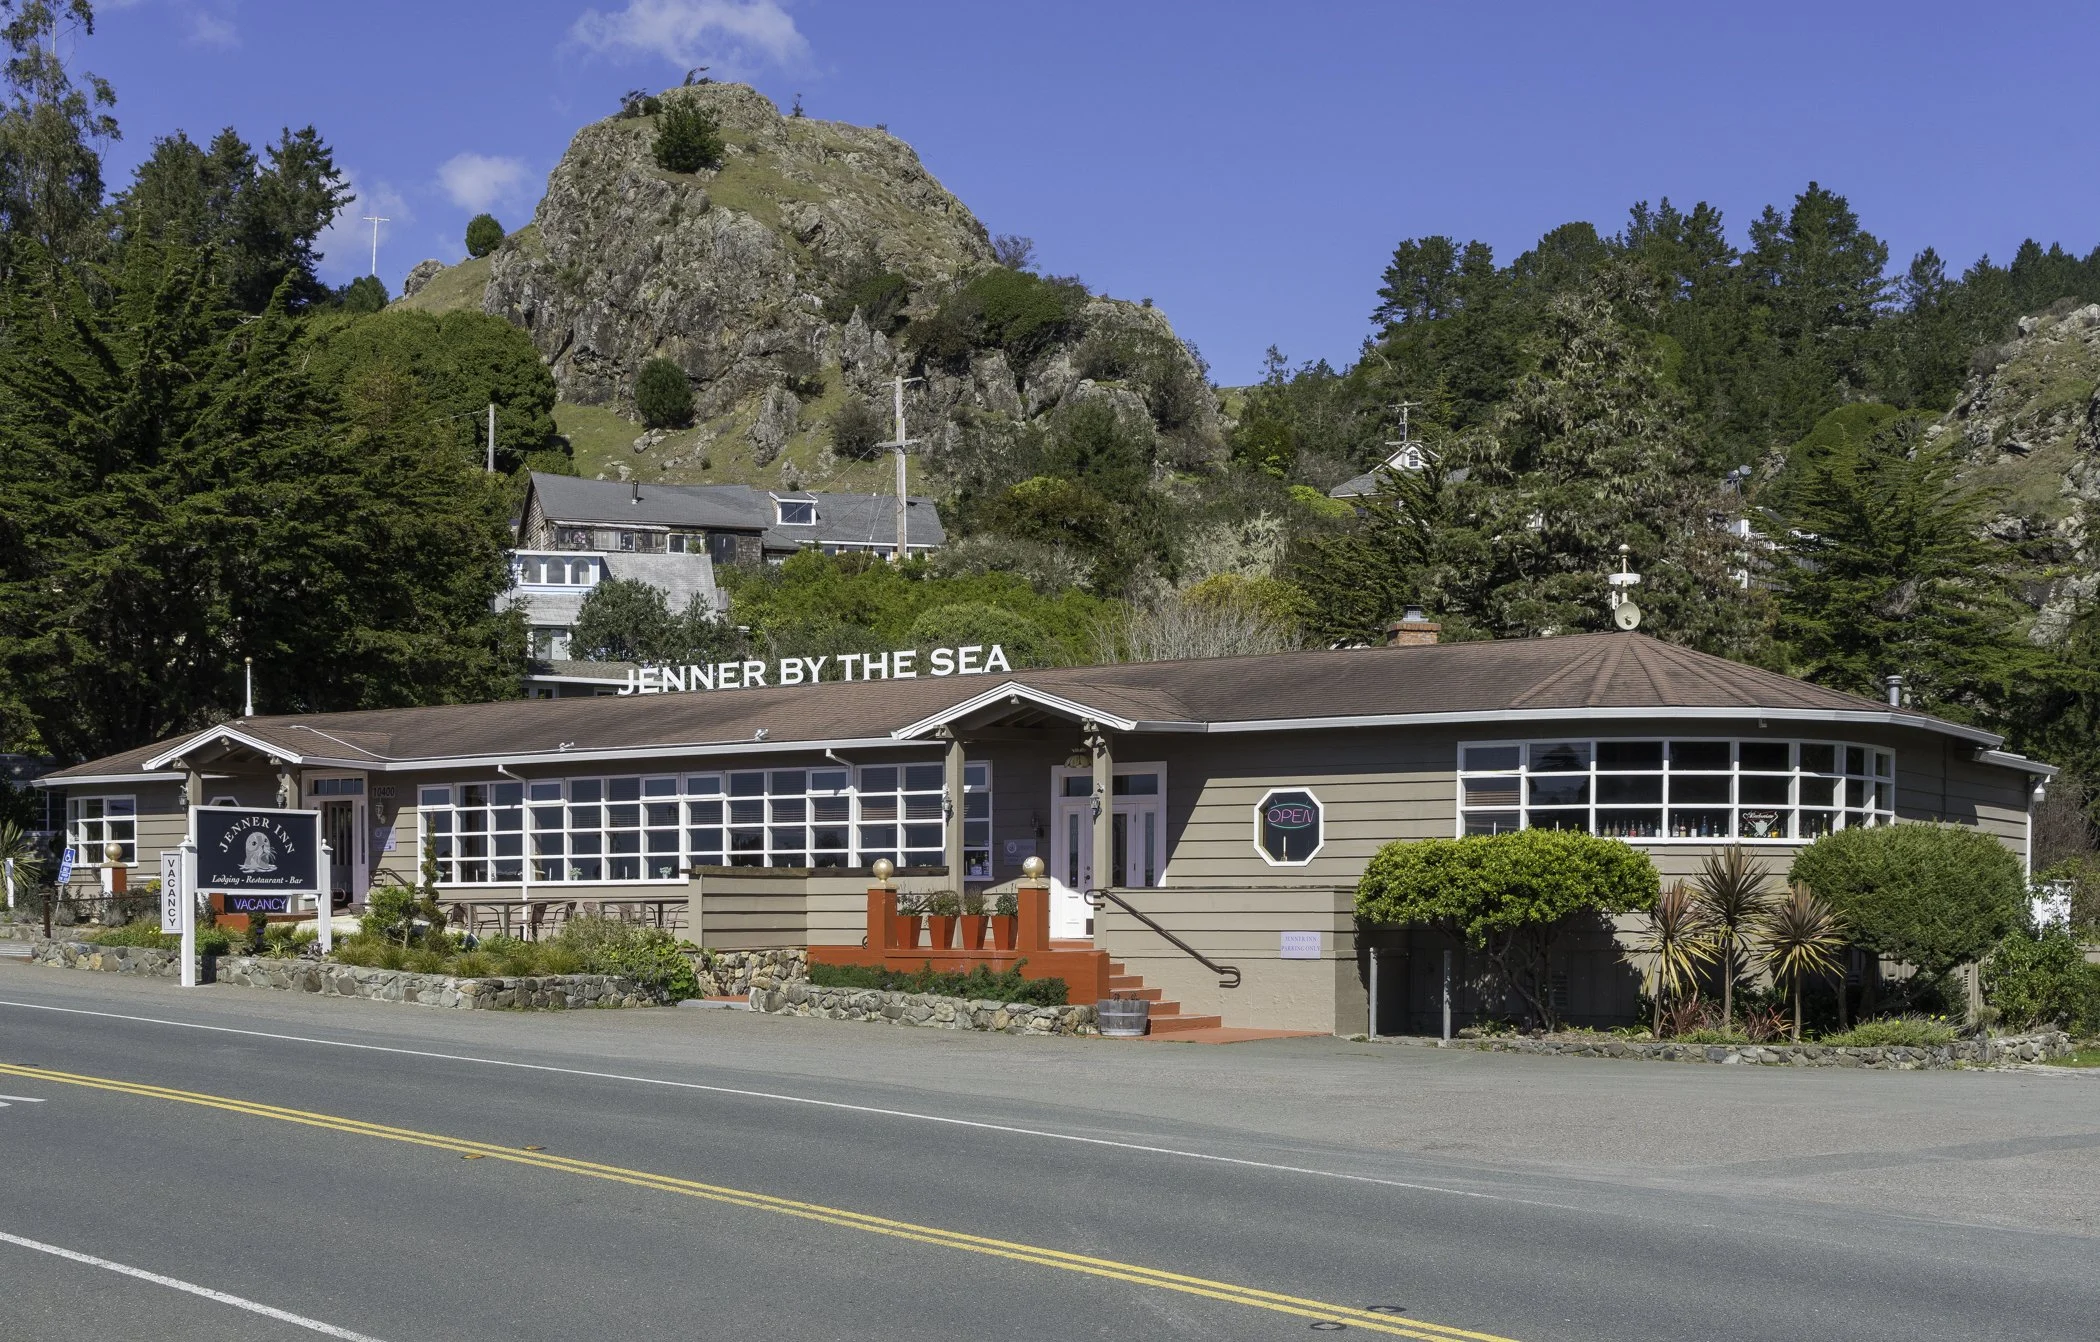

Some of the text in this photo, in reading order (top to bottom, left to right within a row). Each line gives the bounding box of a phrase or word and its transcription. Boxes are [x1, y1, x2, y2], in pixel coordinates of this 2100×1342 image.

[617, 644, 1012, 696] JENNER BY THE SEA
[373, 787, 395, 797] 10400
[1268, 809, 1314, 823] OPEN
[219, 816, 295, 854] JENNER INN
[211, 874, 240, 885] Lodging
[246, 875, 284, 884] Restaurant
[289, 876, 303, 884] Bar
[167, 859, 176, 927] VACANCY
[234, 898, 287, 910] VACANCY
